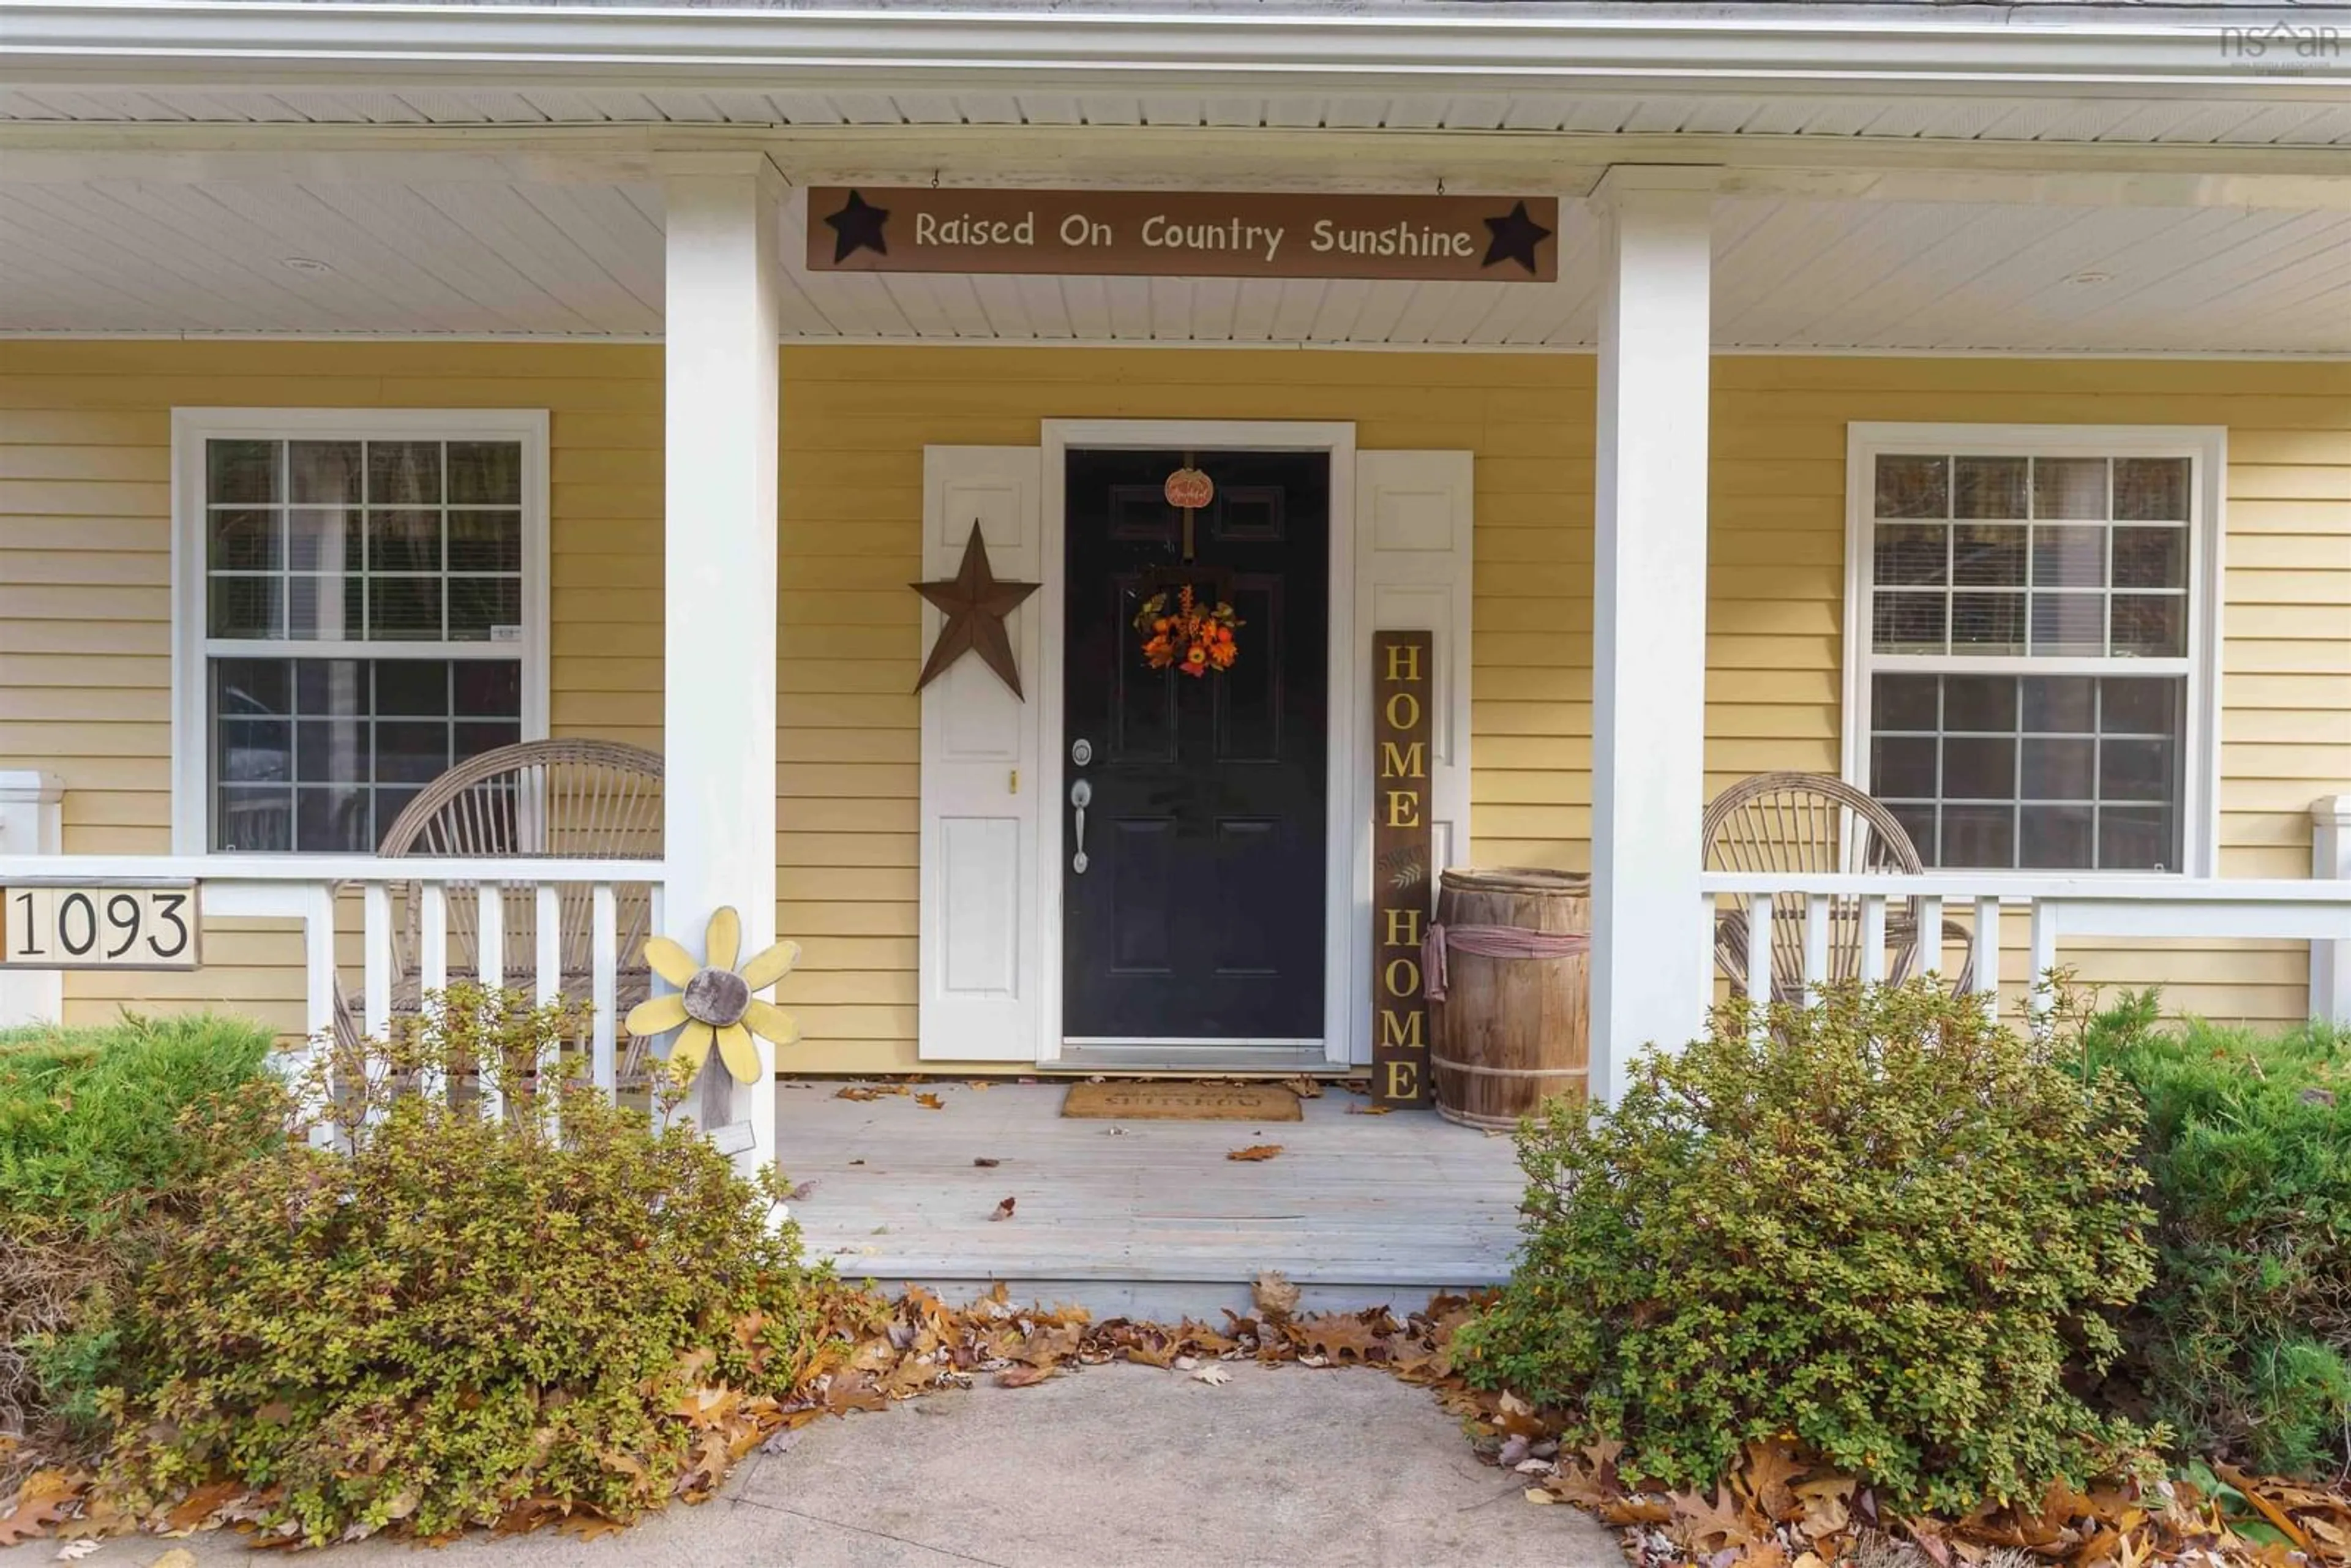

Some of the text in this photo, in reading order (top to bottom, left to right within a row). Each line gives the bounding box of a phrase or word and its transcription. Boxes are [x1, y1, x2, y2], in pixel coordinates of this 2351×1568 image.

[916, 211, 1475, 261] Raised On Country Sunshine
[1381, 645, 1425, 827] HOME
[16, 893, 187, 959] 1093
[1381, 909, 1425, 1099] HOME
